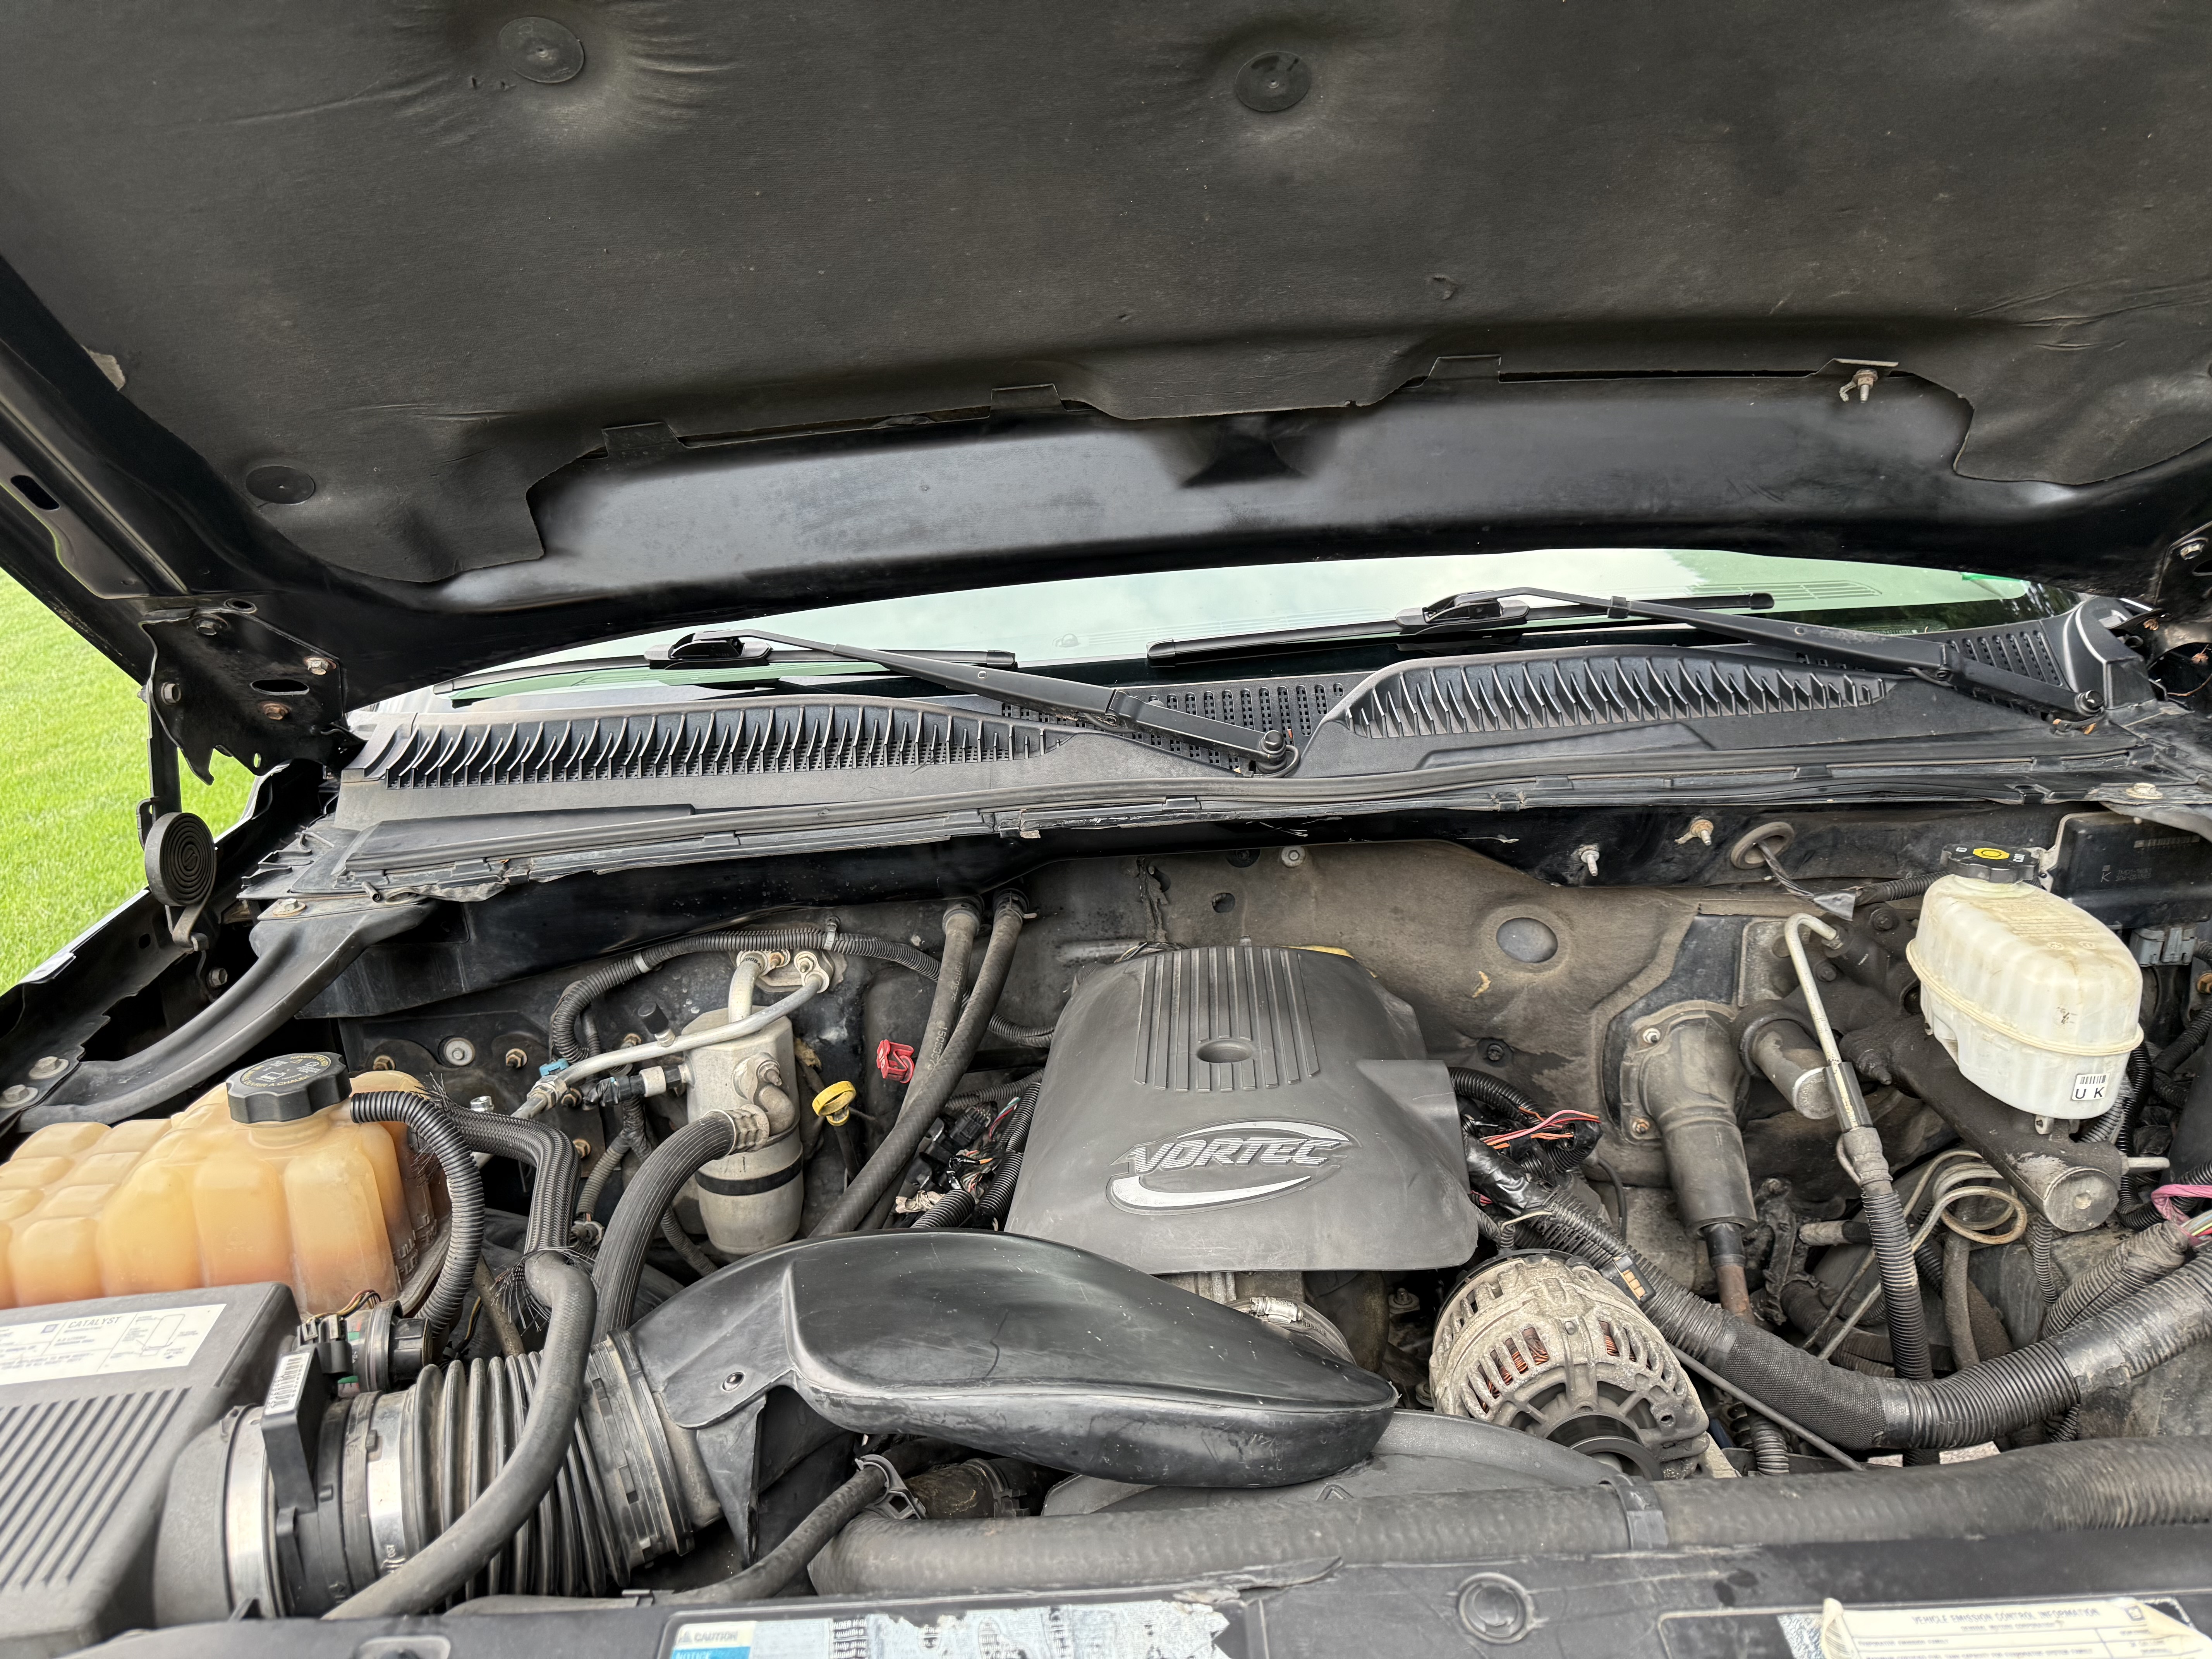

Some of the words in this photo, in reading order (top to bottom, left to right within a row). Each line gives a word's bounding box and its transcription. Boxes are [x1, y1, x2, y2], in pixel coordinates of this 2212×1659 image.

[2100, 872, 2111, 883] K
[2075, 1088, 2087, 1099] U
[2094, 1086, 2105, 1098] K
[1128, 1137, 1341, 1173] VORTEC
[69, 1316, 122, 1328] CATALYST
[1911, 1614, 1949, 1625] VEHICLE
[1950, 1613, 1993, 1623] EMISSION
[1995, 1611, 2037, 1621] CONTROL
[2038, 1608, 2100, 1620] INFORMATION
[694, 1630, 738, 1642] CAUTION
